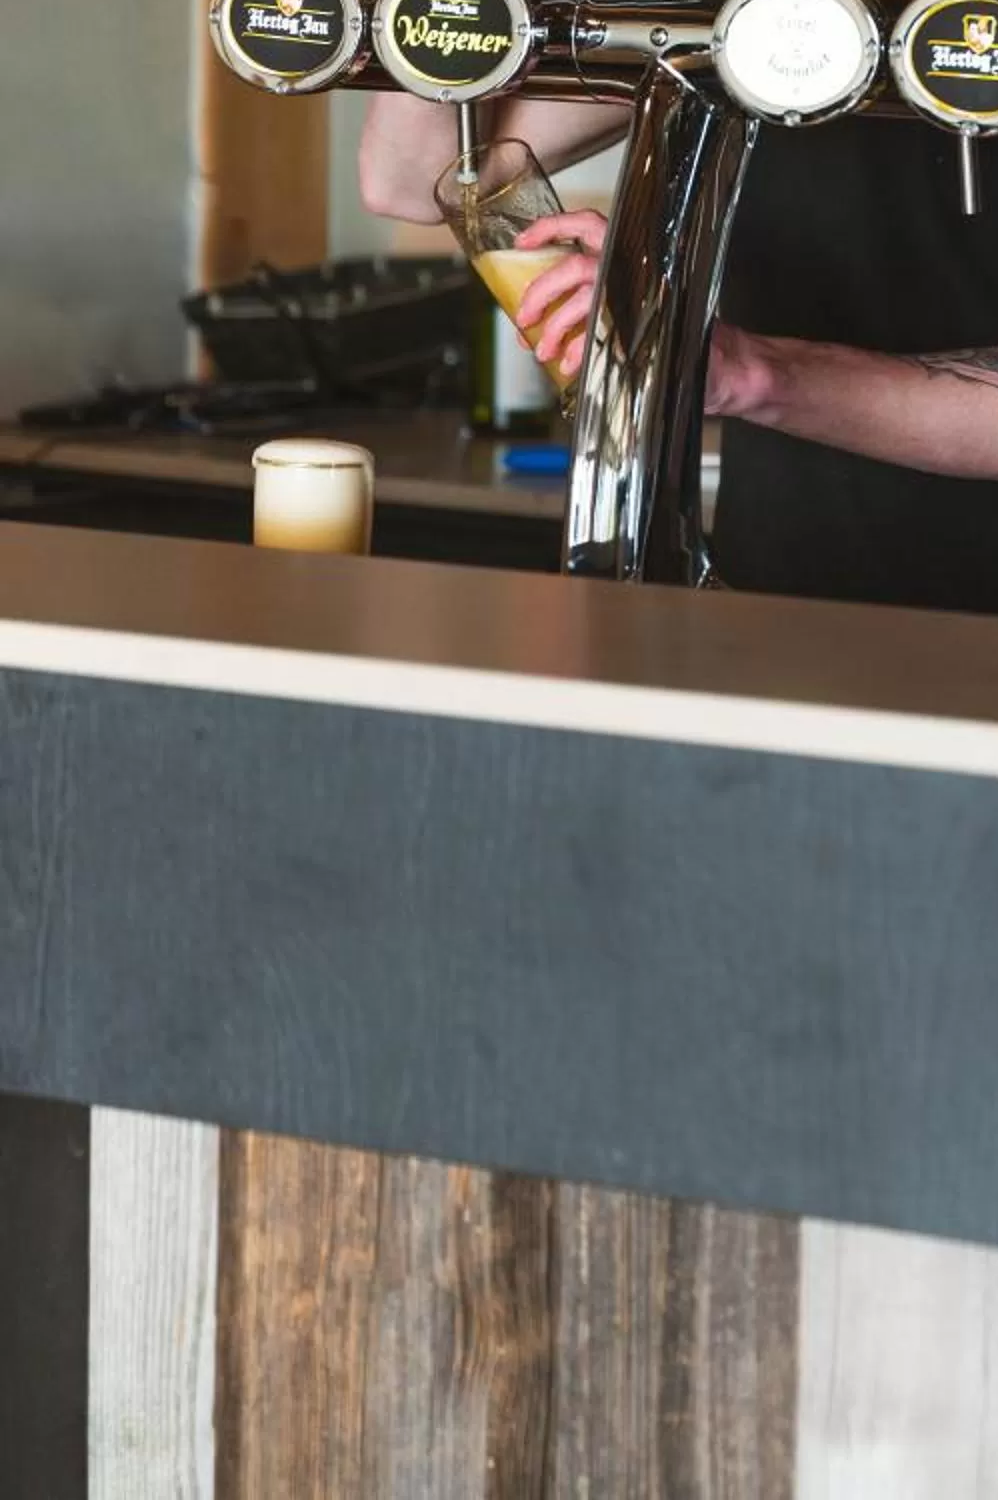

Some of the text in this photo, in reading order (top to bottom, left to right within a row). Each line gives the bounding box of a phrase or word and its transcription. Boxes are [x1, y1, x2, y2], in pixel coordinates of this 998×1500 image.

[246, 7, 329, 37] Hertog Jan
[397, 15, 512, 57] Weizener
[931, 45, 992, 73] Hertog
